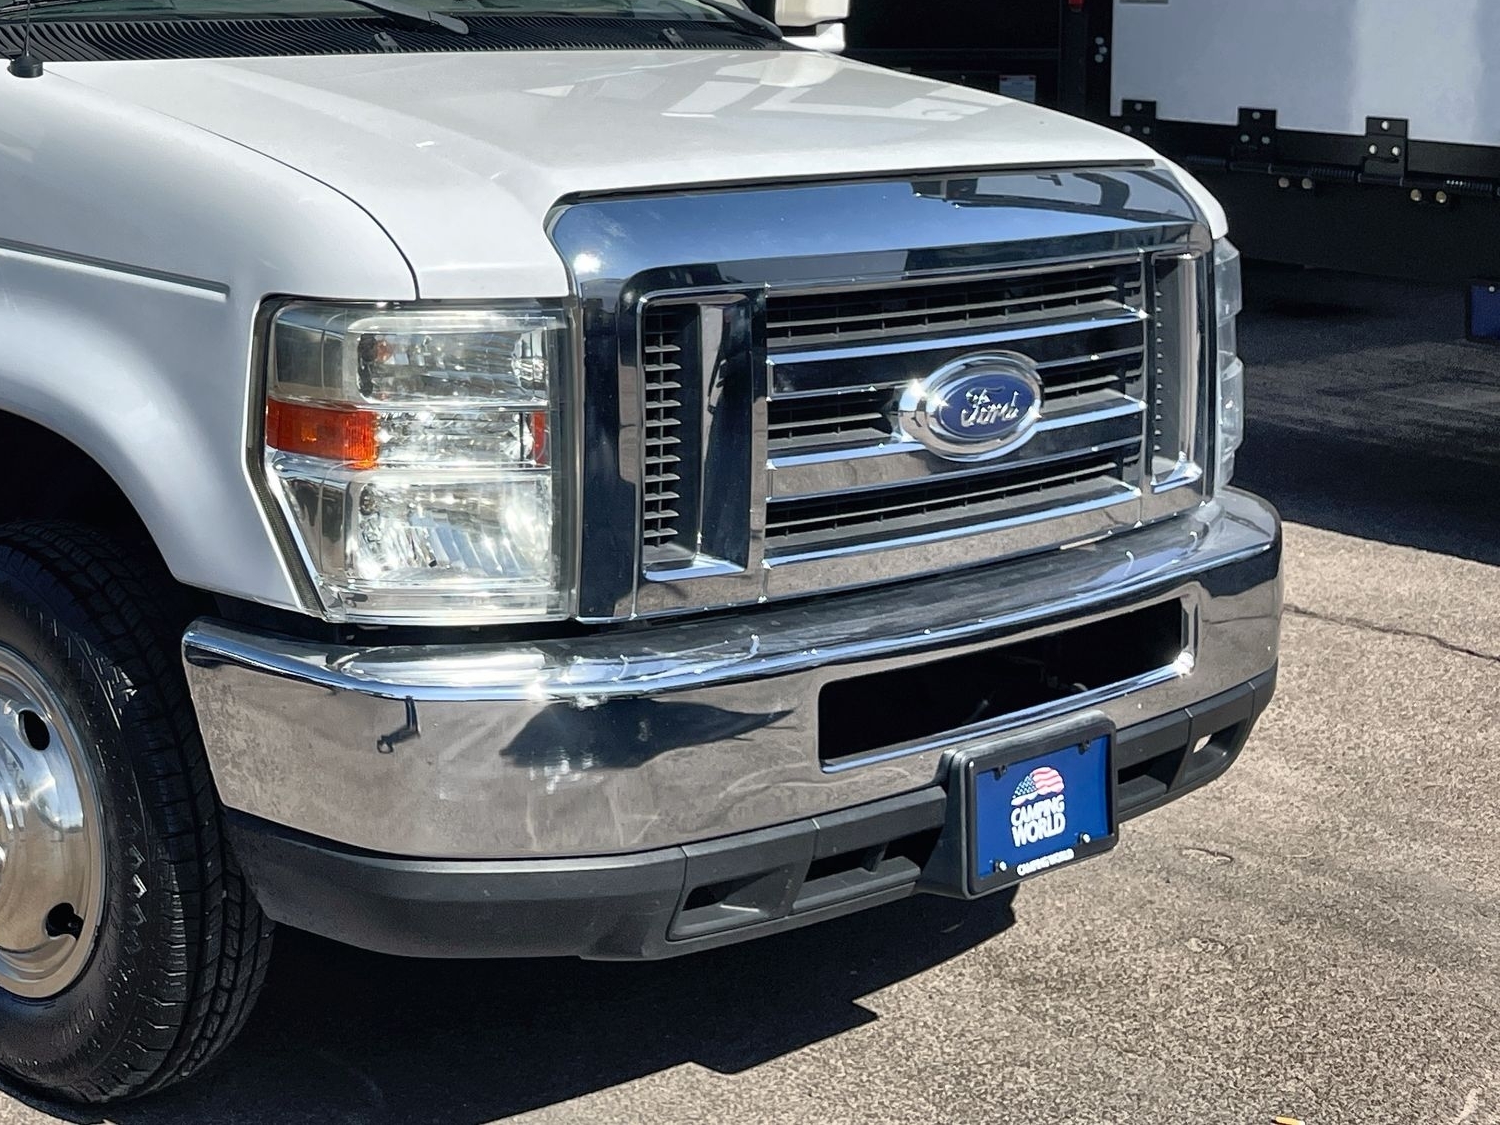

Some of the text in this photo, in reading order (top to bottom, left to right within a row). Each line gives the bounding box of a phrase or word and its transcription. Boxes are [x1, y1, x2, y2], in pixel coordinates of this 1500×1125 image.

[960, 386, 1020, 428] Ford
[1010, 794, 1066, 826] CAMPING
[1012, 813, 1066, 847] WORLD
